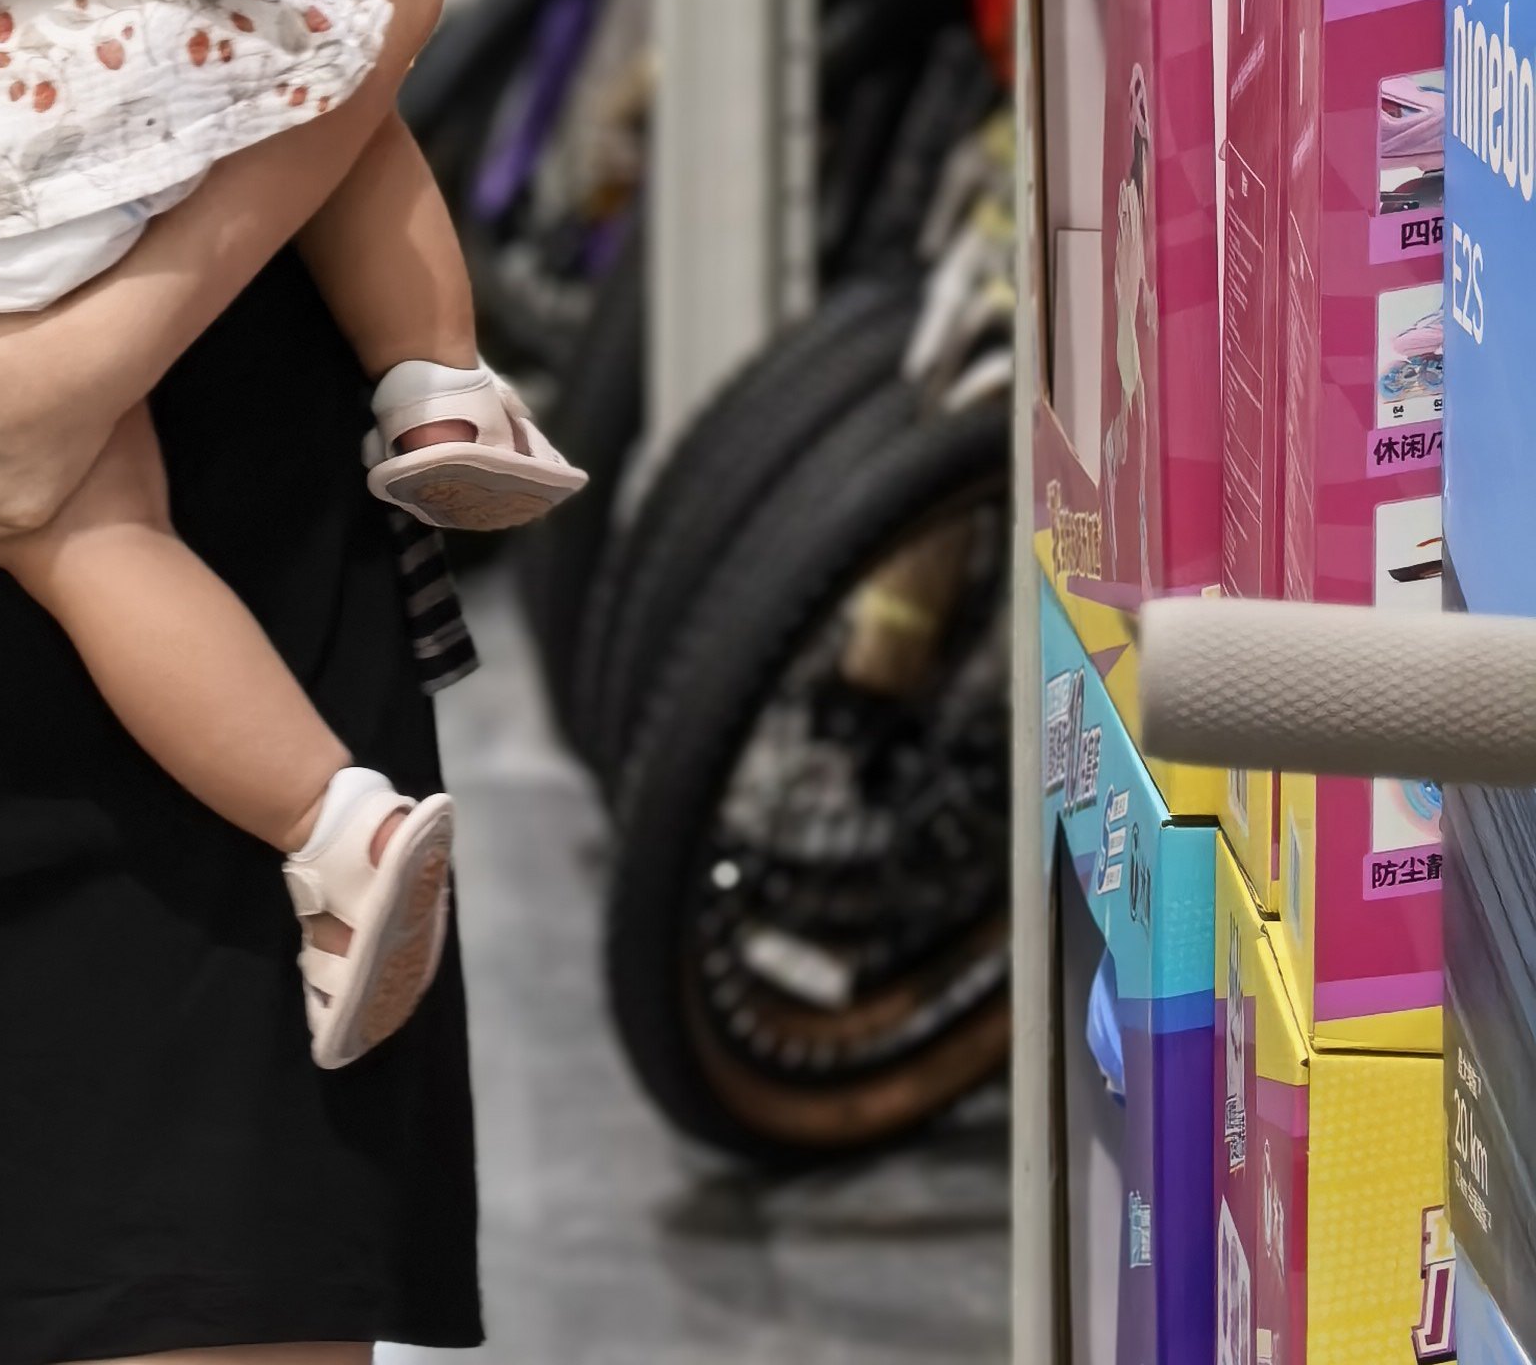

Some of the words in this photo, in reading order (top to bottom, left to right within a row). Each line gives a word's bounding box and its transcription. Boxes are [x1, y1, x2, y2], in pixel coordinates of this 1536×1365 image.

[1452, 222, 1484, 346] E2S
[1373, 431, 1443, 466] 休闲/
[1454, 1087, 1468, 1162] 20
[1470, 1106, 1489, 1196] km
